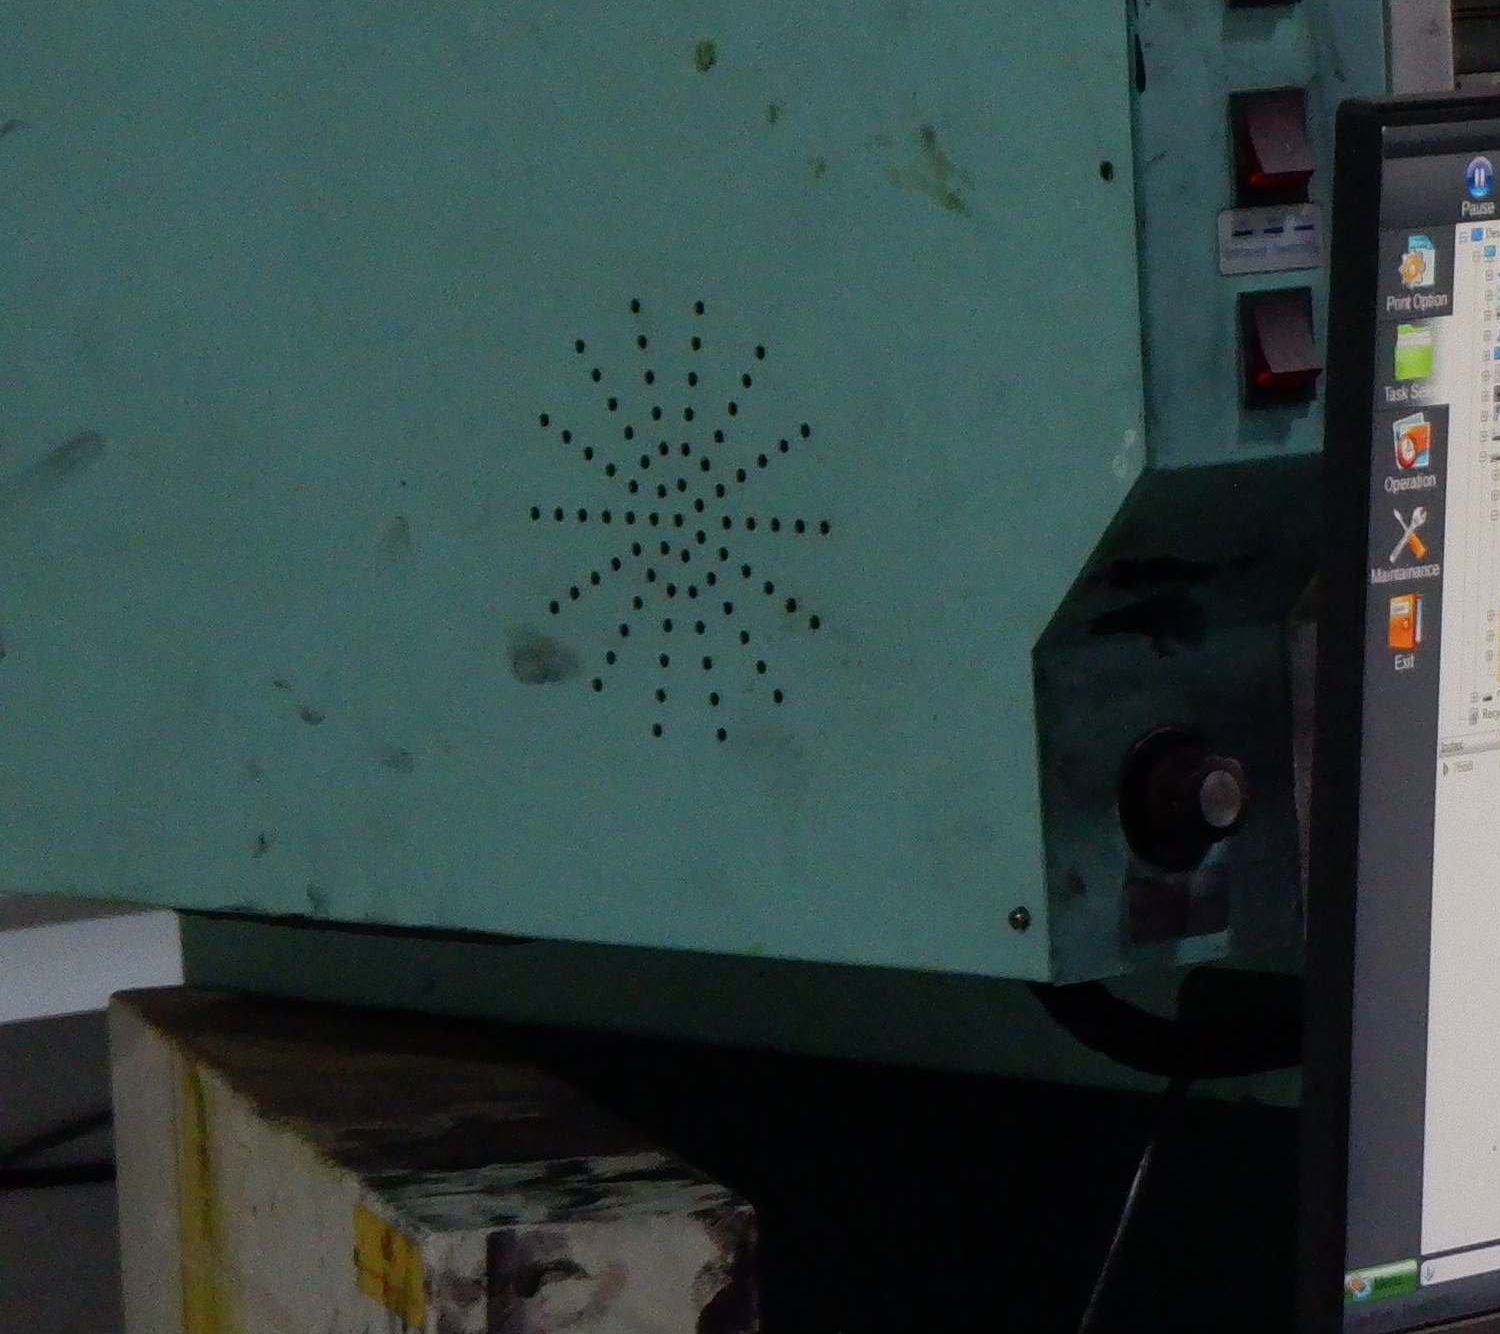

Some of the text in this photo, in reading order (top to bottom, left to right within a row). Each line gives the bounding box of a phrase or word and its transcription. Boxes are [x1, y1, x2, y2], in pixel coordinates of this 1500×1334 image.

[1461, 200, 1495, 217] Pause
[1387, 292, 1448, 313] Print Option
[1385, 386, 1409, 403] Task
[1384, 472, 1437, 493] Operation
[1394, 653, 1416, 671] Exit
